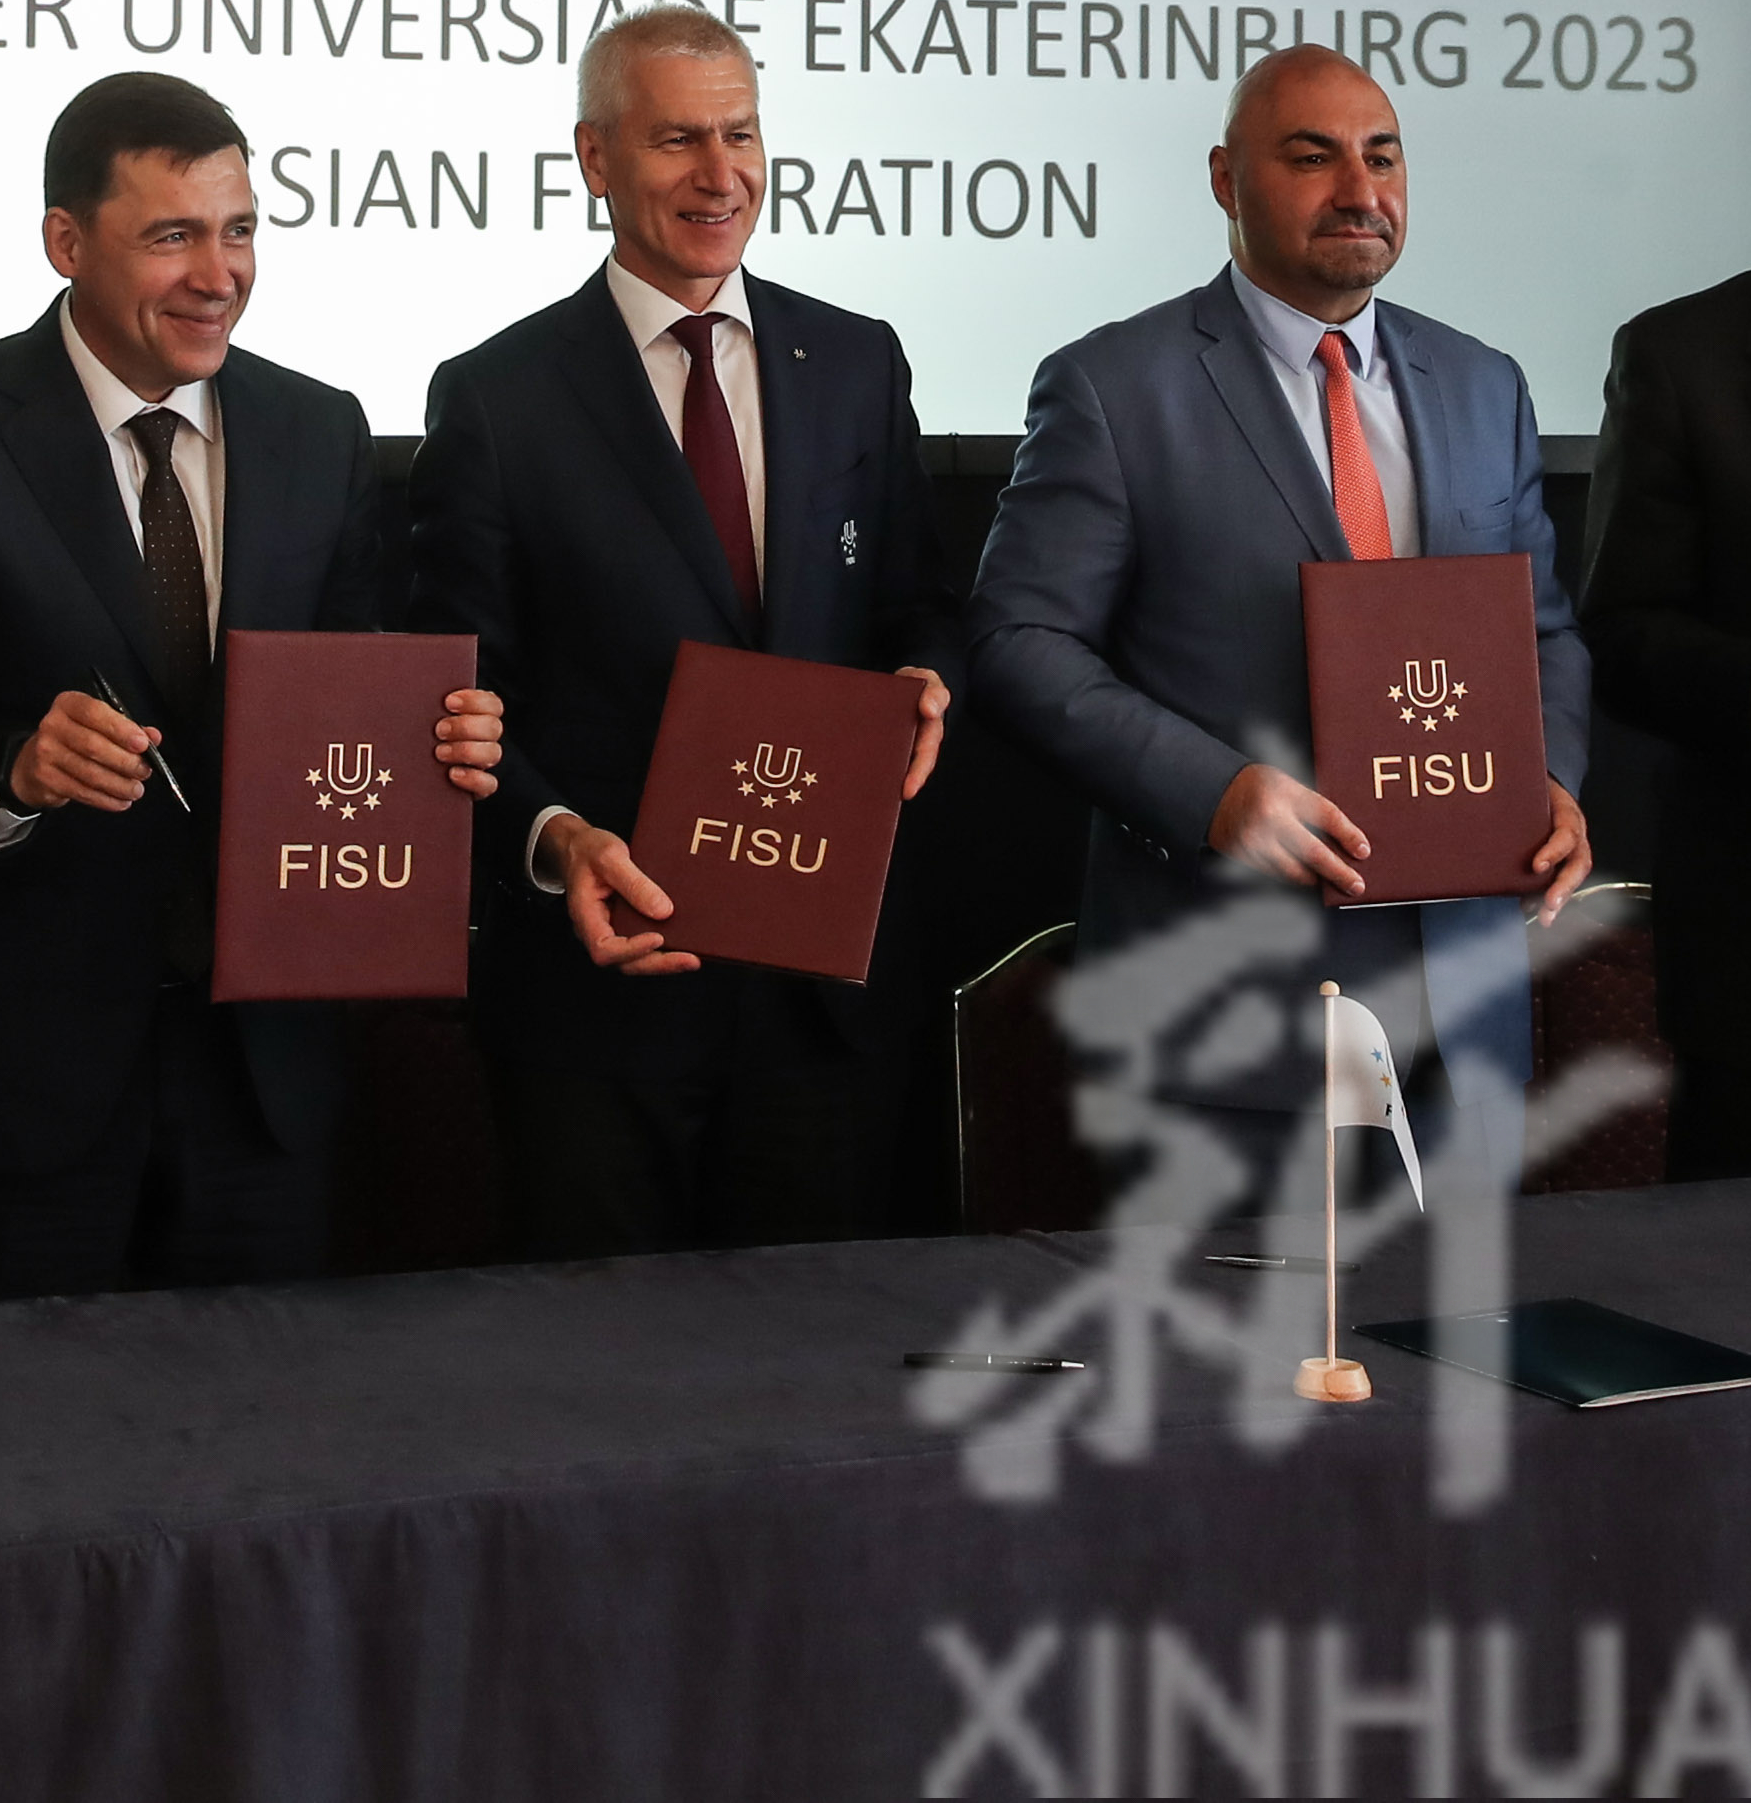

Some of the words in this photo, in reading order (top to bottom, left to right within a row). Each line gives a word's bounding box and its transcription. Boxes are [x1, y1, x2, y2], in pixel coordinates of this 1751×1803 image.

[1499, 11, 1698, 95] 2023
[533, 153, 1098, 239] FRATION
[1373, 750, 1495, 800] FISU
[278, 842, 413, 891] FISU
[688, 817, 829, 874] FISU
